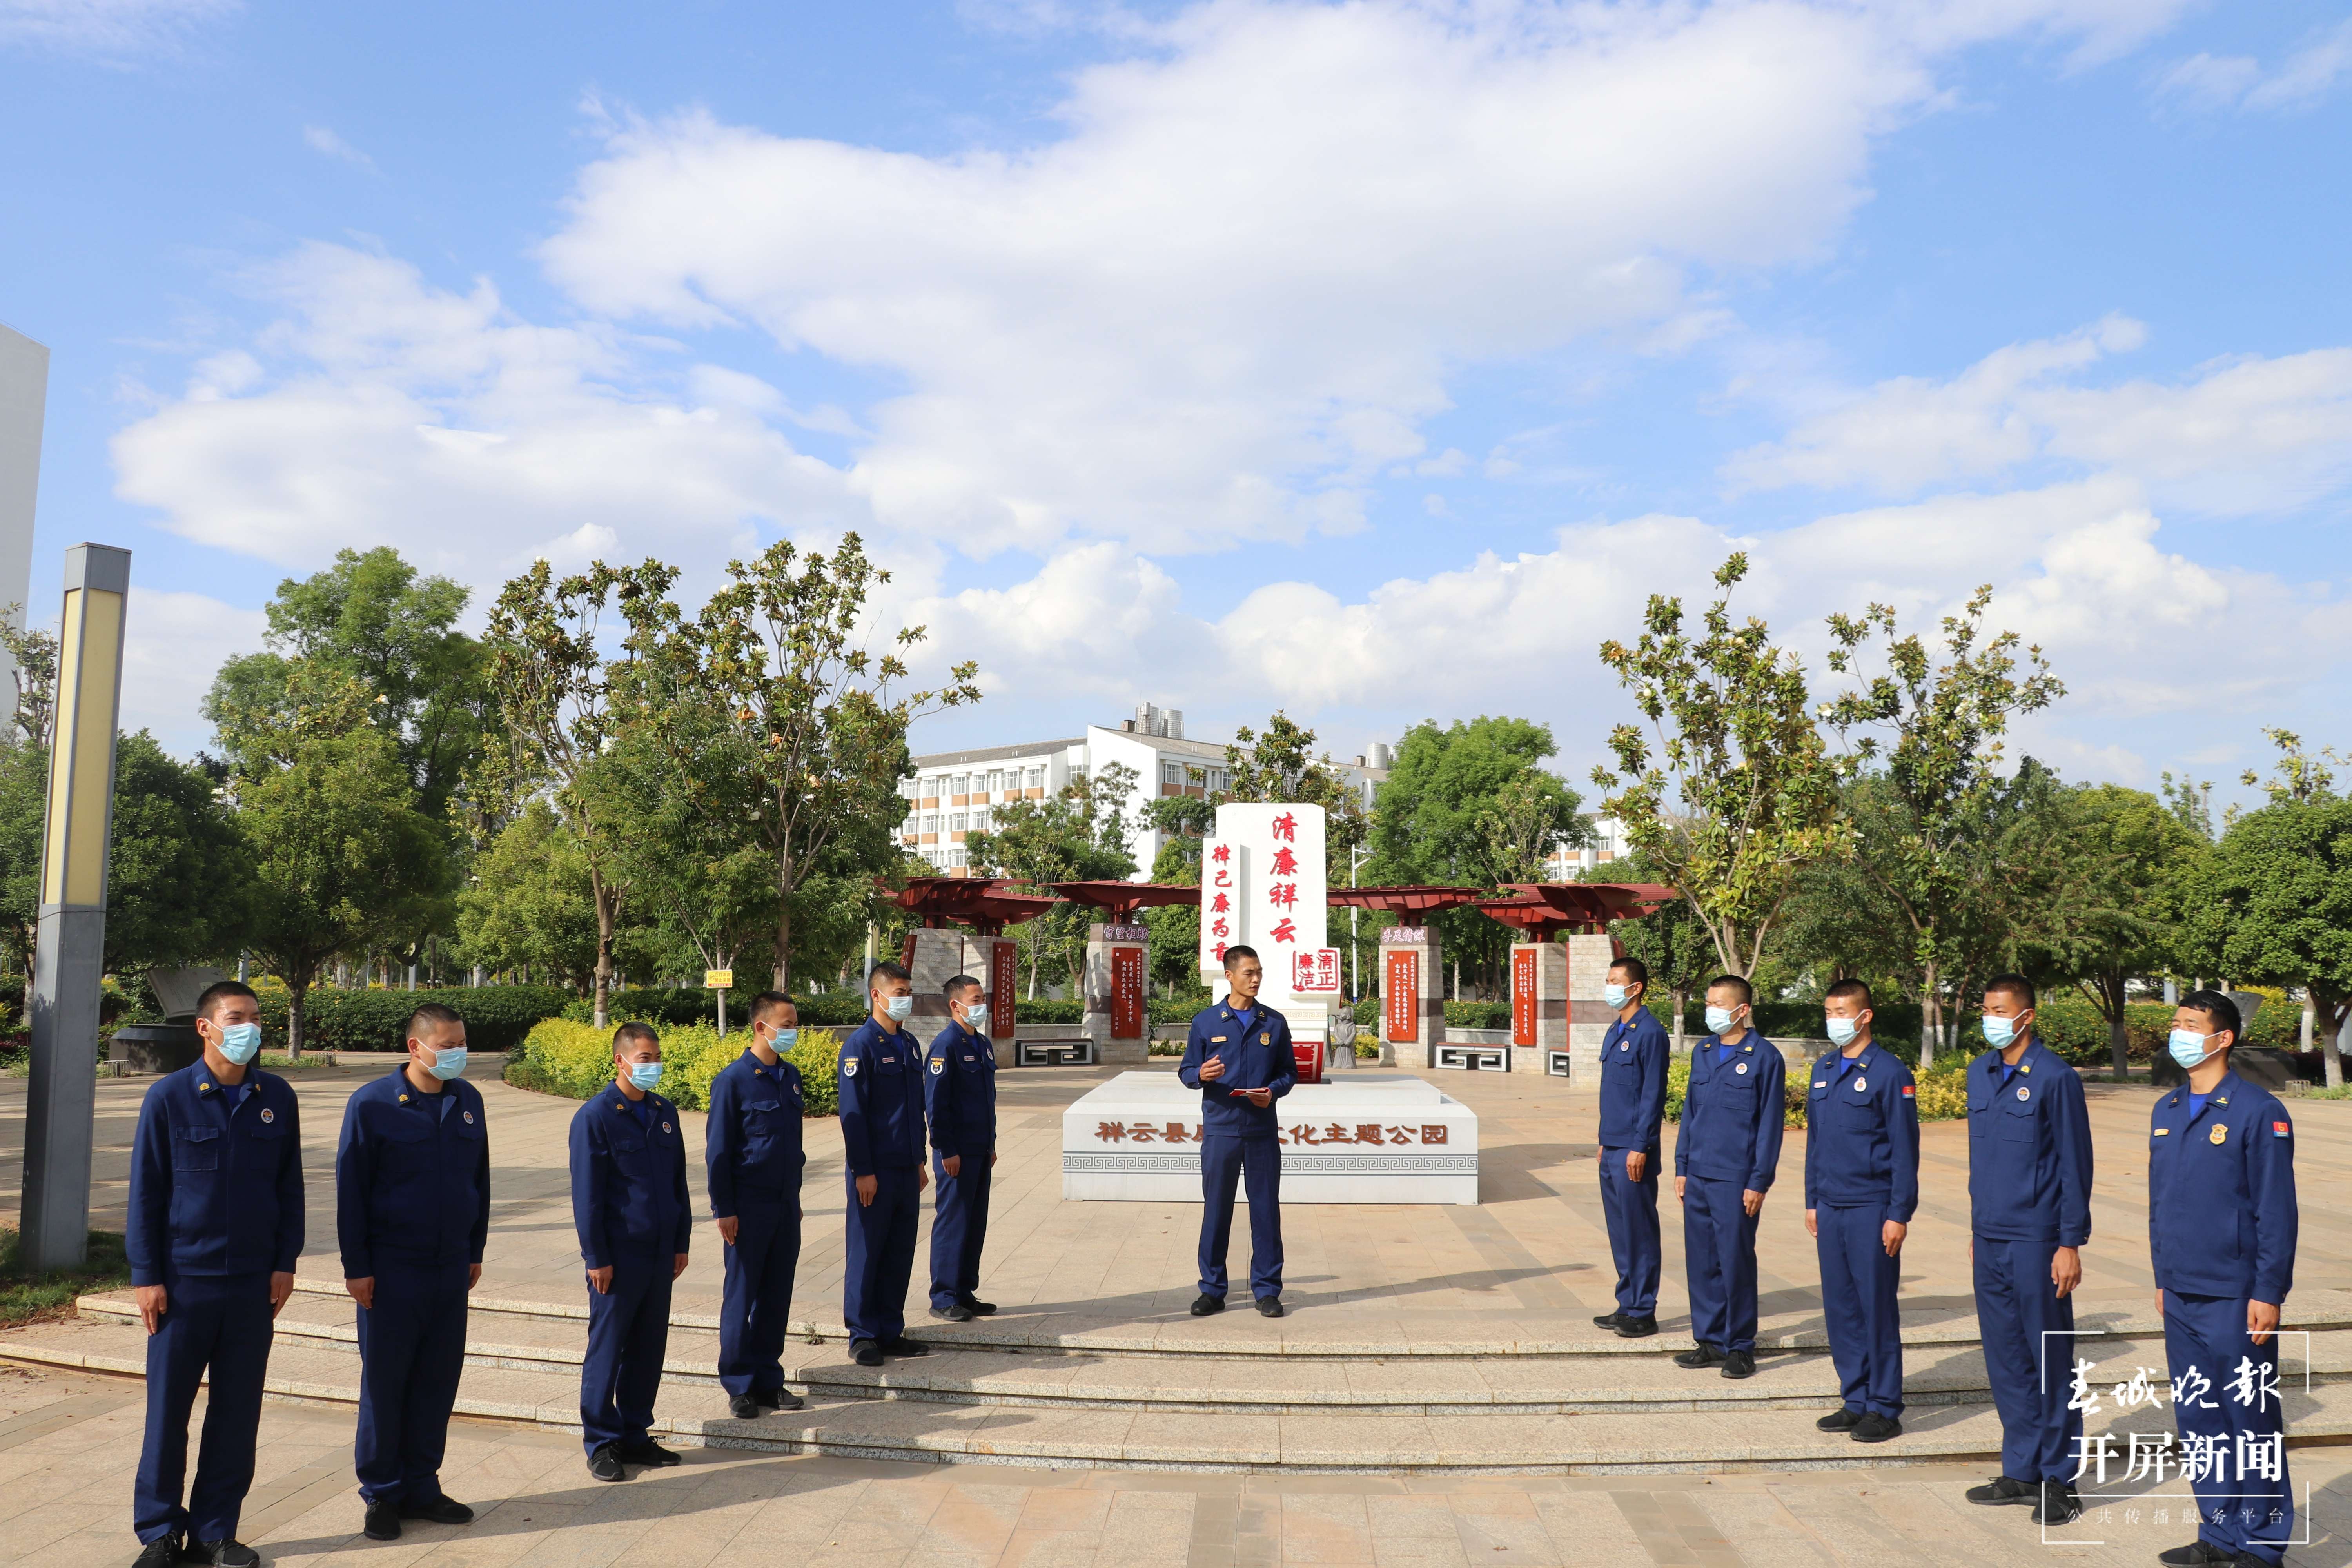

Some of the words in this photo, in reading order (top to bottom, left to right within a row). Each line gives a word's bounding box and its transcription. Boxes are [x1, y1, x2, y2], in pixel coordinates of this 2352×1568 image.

[1269, 811, 1299, 943] 清廉祥云
[1210, 844, 1232, 962] 律己廉为首
[1103, 925, 1149, 940] 守望相助
[1382, 928, 1425, 943] 手足情深
[1094, 1122, 1447, 1145] 祥云县化主题公园
